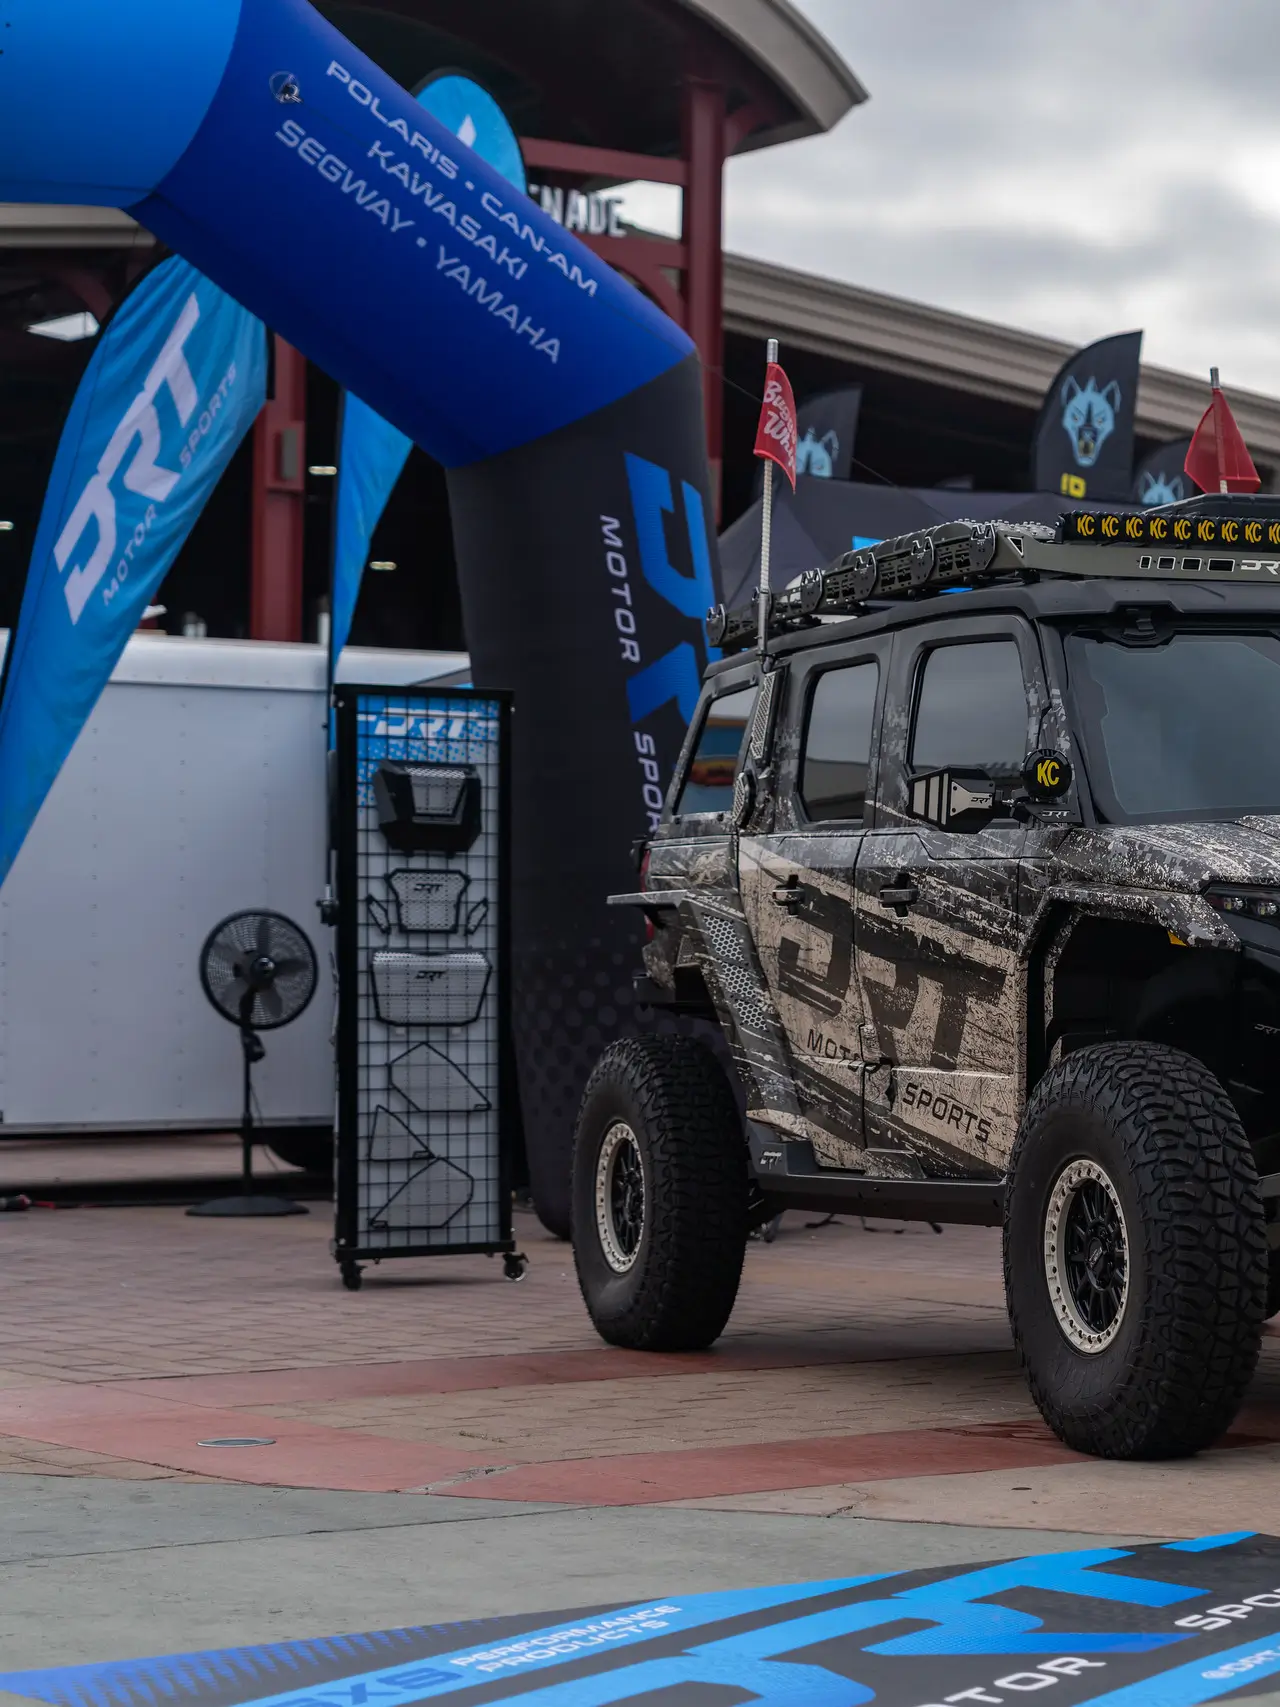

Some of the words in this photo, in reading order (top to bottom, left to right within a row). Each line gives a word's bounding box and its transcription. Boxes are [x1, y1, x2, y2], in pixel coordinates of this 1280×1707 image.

[326, 60, 459, 180] POLARIS
[481, 191, 599, 297] CAN-AM
[367, 140, 529, 280] KAWASAKI
[529, 183, 627, 237] NADE
[275, 119, 415, 233] SEGWAY
[436, 245, 561, 363] YAMAHA
[53, 291, 200, 626] DRT
[103, 503, 158, 606] MOTOR
[179, 361, 238, 469] SPORTS
[1078, 515, 1094, 536] KC
[1102, 516, 1118, 536] KC
[1126, 517, 1142, 538] KC
[1150, 518, 1166, 538] KC
[1174, 519, 1190, 539] KC
[1198, 520, 1214, 541] KC
[1222, 521, 1238, 542] KC
[1245, 522, 1261, 542] KC
[600, 514, 641, 665] MOTOR
[634, 730, 662, 835] SPOR
[374, 707, 481, 747] DRT
[1037, 759, 1060, 787] KC
[1041, 810, 1071, 819] DRT
[902, 1082, 992, 1143] SPORTS
[450, 1605, 683, 1667] PERFORMANCE
[475, 1620, 669, 1672] PRODUCTS
[268, 1666, 463, 1707] XS
[913, 1656, 1108, 1707] TOR
